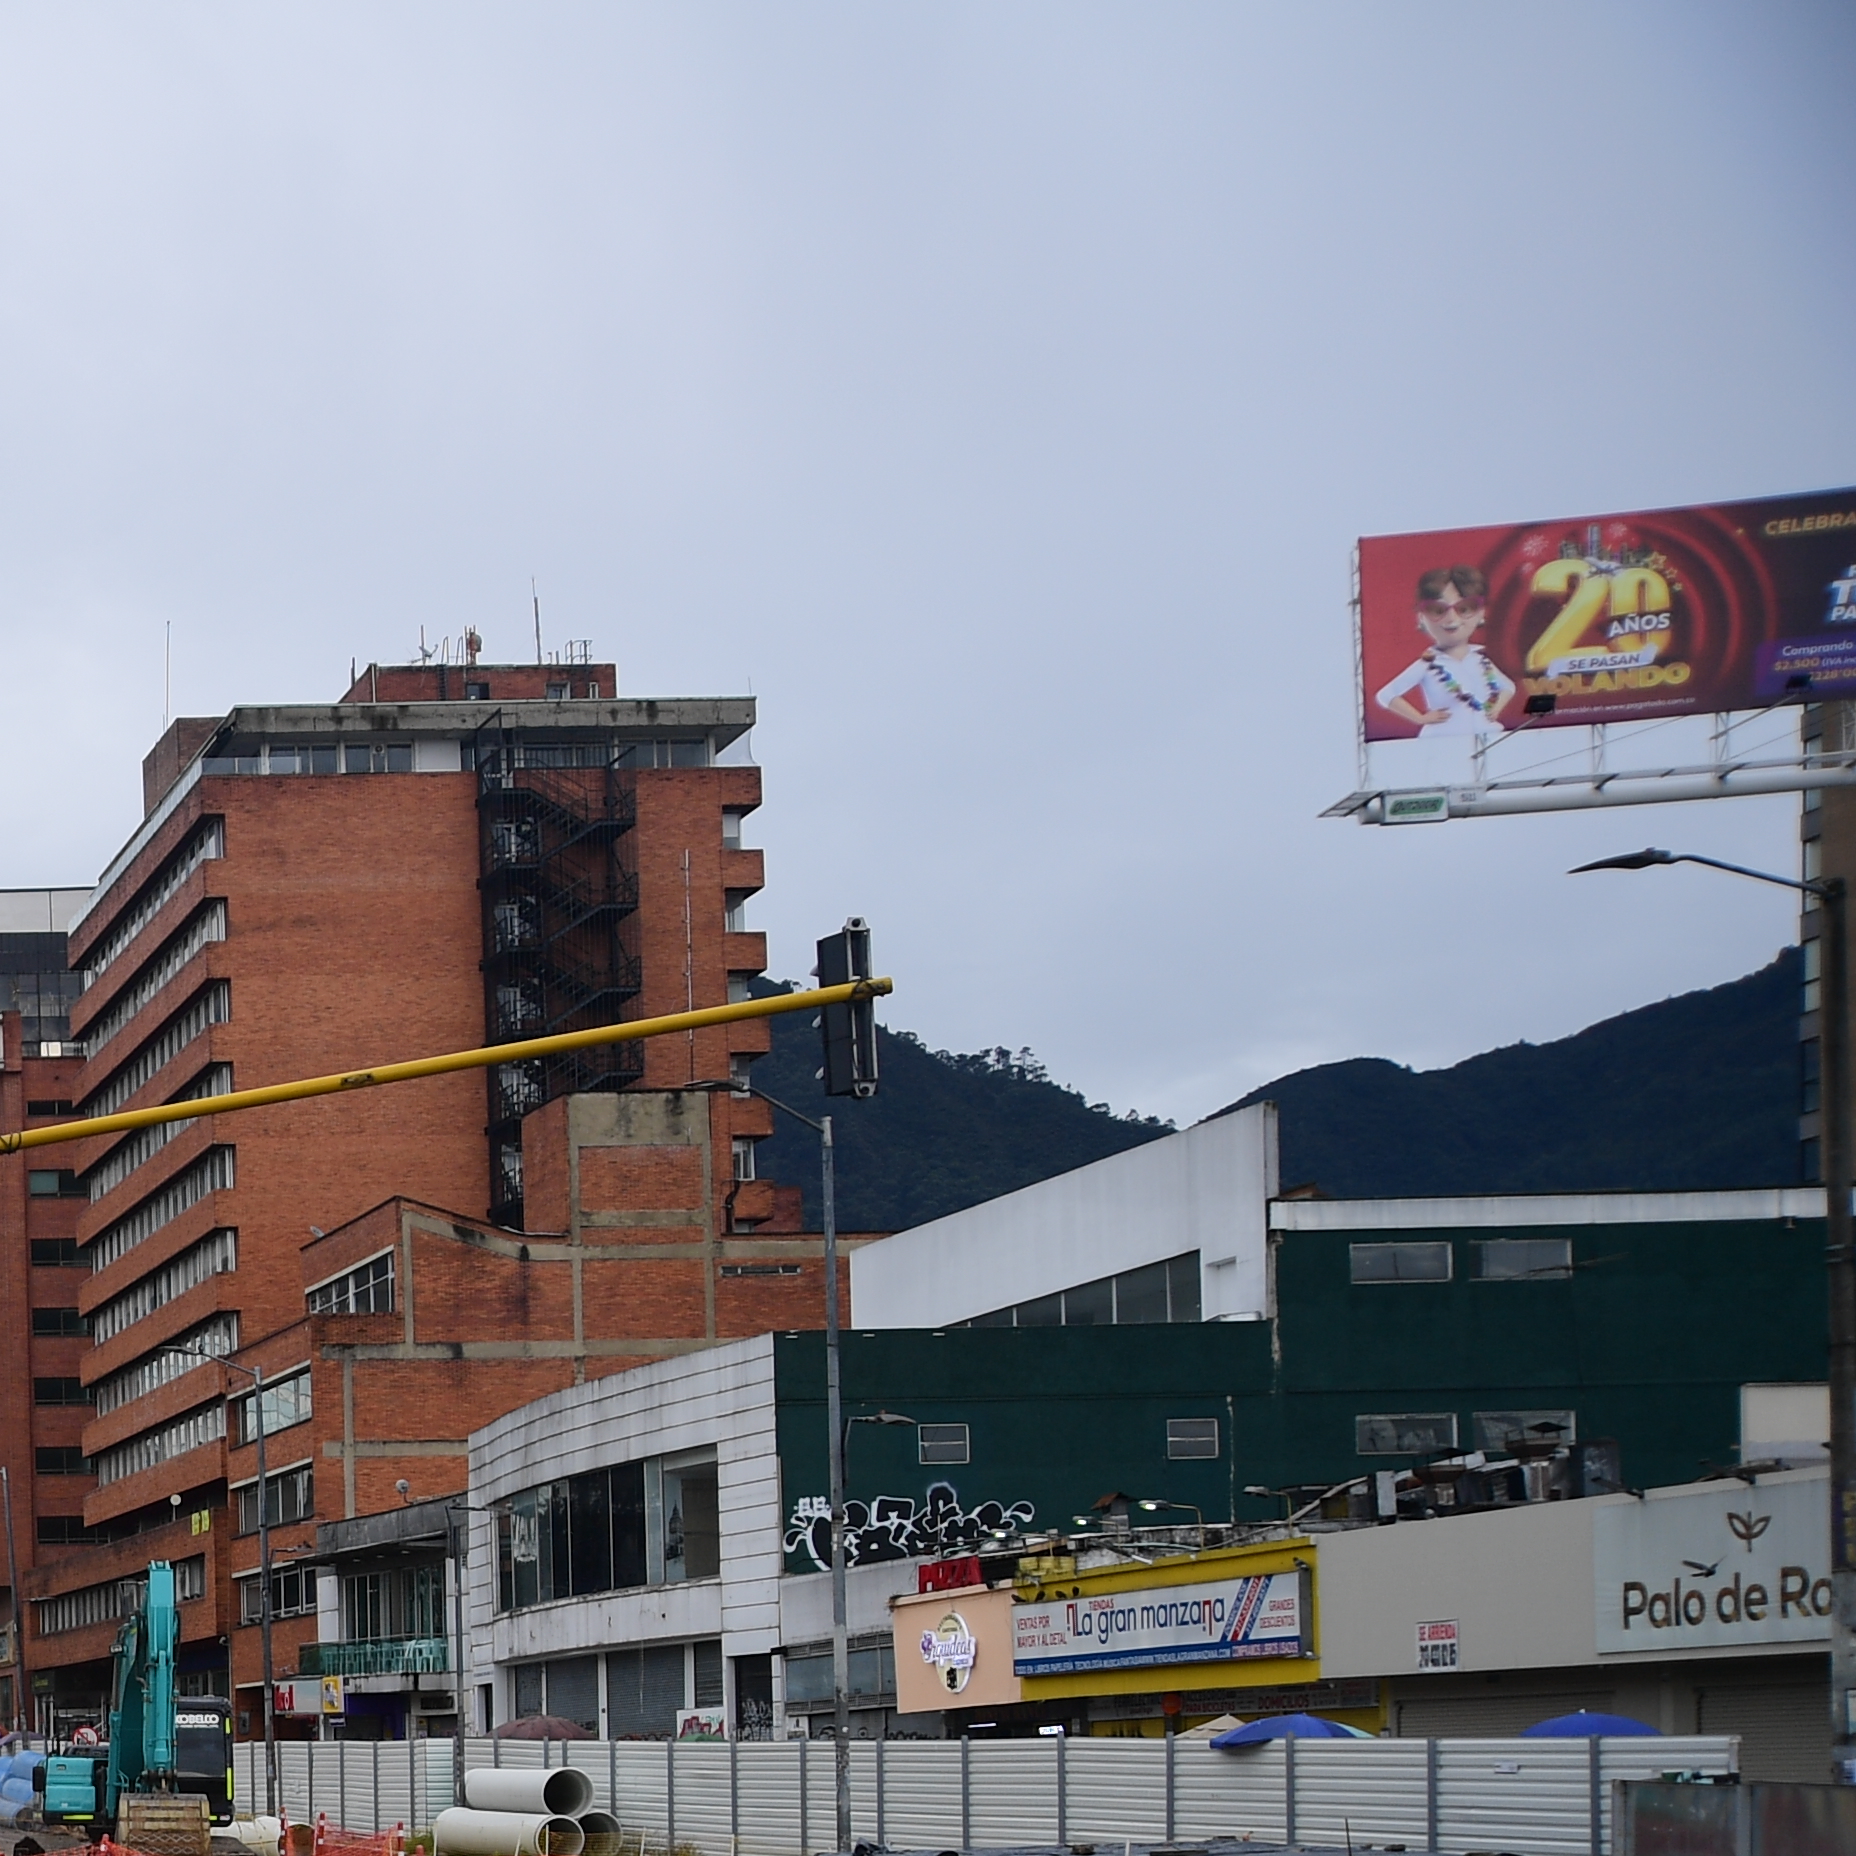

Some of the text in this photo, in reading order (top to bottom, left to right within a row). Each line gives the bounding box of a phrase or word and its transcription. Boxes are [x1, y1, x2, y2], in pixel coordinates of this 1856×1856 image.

[1606, 611, 1672, 640] AÑOS
[1782, 640, 1855, 657] Comprando
[1568, 653, 1641, 671] SE PASAN
[1522, 662, 1692, 697] VOLANDO
[918, 1555, 983, 1594] PIZZA
[1089, 1598, 1115, 1612] TIENDAS
[1622, 1577, 1706, 1631] Palo
[1716, 1571, 1768, 1624] de
[1016, 1616, 1037, 1631] VENTAS
[1075, 1602, 1093, 1637] La
[1097, 1606, 1137, 1645] gran
[1140, 1597, 1226, 1637] manzana
[1016, 1634, 1036, 1648] MAYOR
[1041, 1633, 1050, 1645] AL
